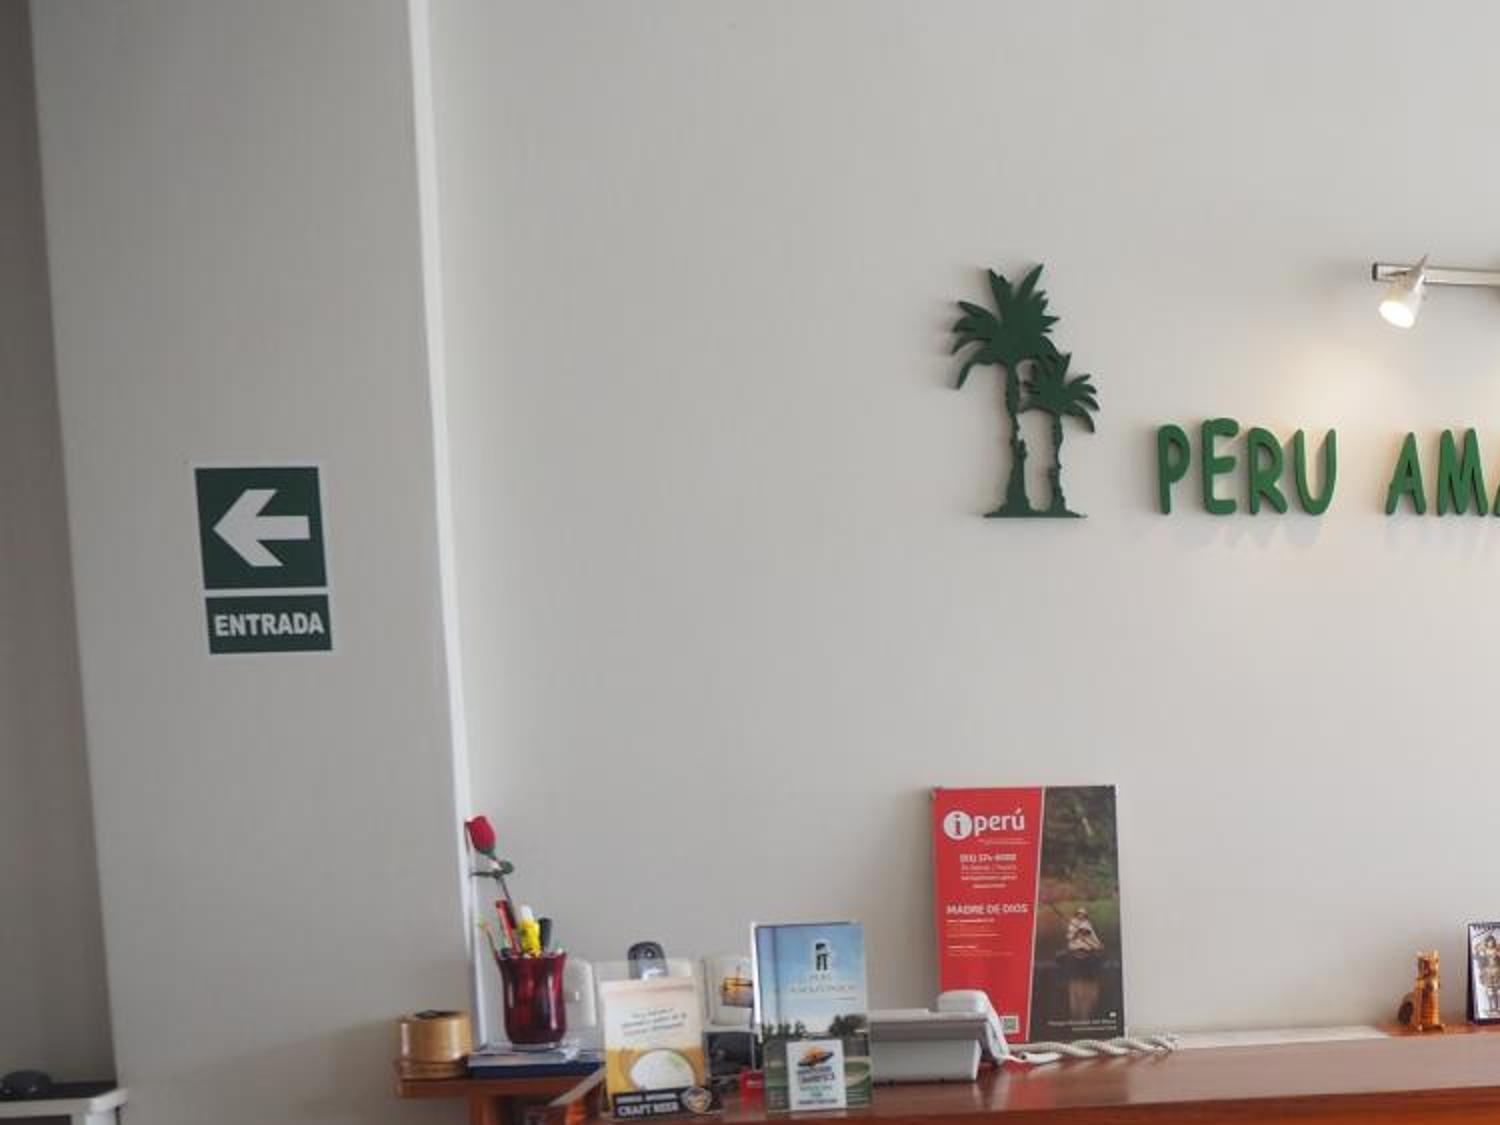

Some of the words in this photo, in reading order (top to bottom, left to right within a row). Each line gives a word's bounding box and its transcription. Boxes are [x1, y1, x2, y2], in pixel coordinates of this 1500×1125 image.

[1157, 418, 1337, 517] PERU
[214, 612, 325, 637] ENTRADA
[945, 904, 984, 916] MADRE
[986, 903, 1000, 915] DE
[1001, 902, 1029, 914] DIOS
